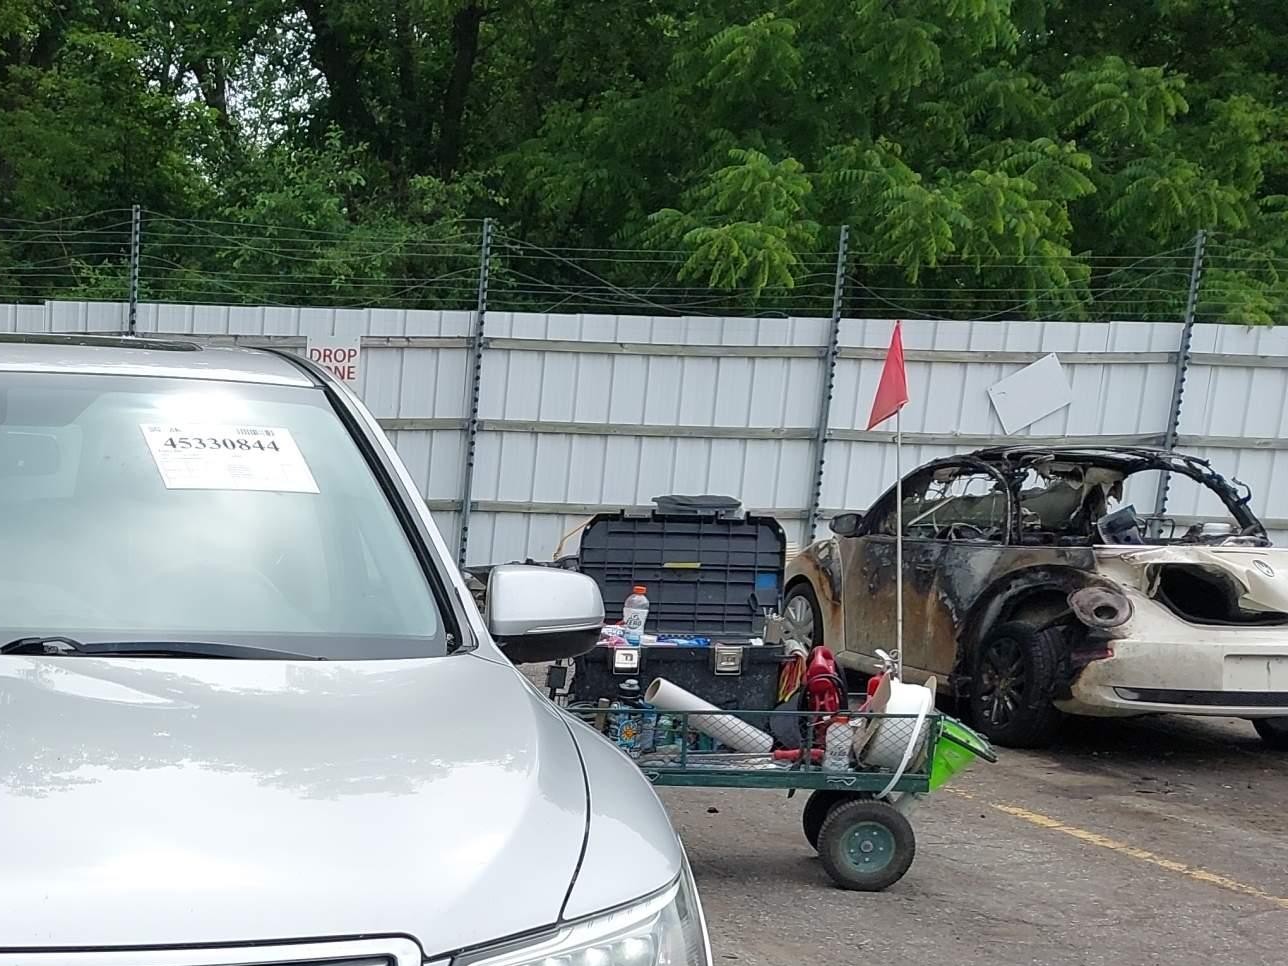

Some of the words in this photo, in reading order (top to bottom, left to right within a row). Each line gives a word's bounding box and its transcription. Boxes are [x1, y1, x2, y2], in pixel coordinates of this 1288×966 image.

[309, 348, 358, 363] DROP
[324, 365, 356, 380] NE
[163, 437, 281, 452] 45330844
